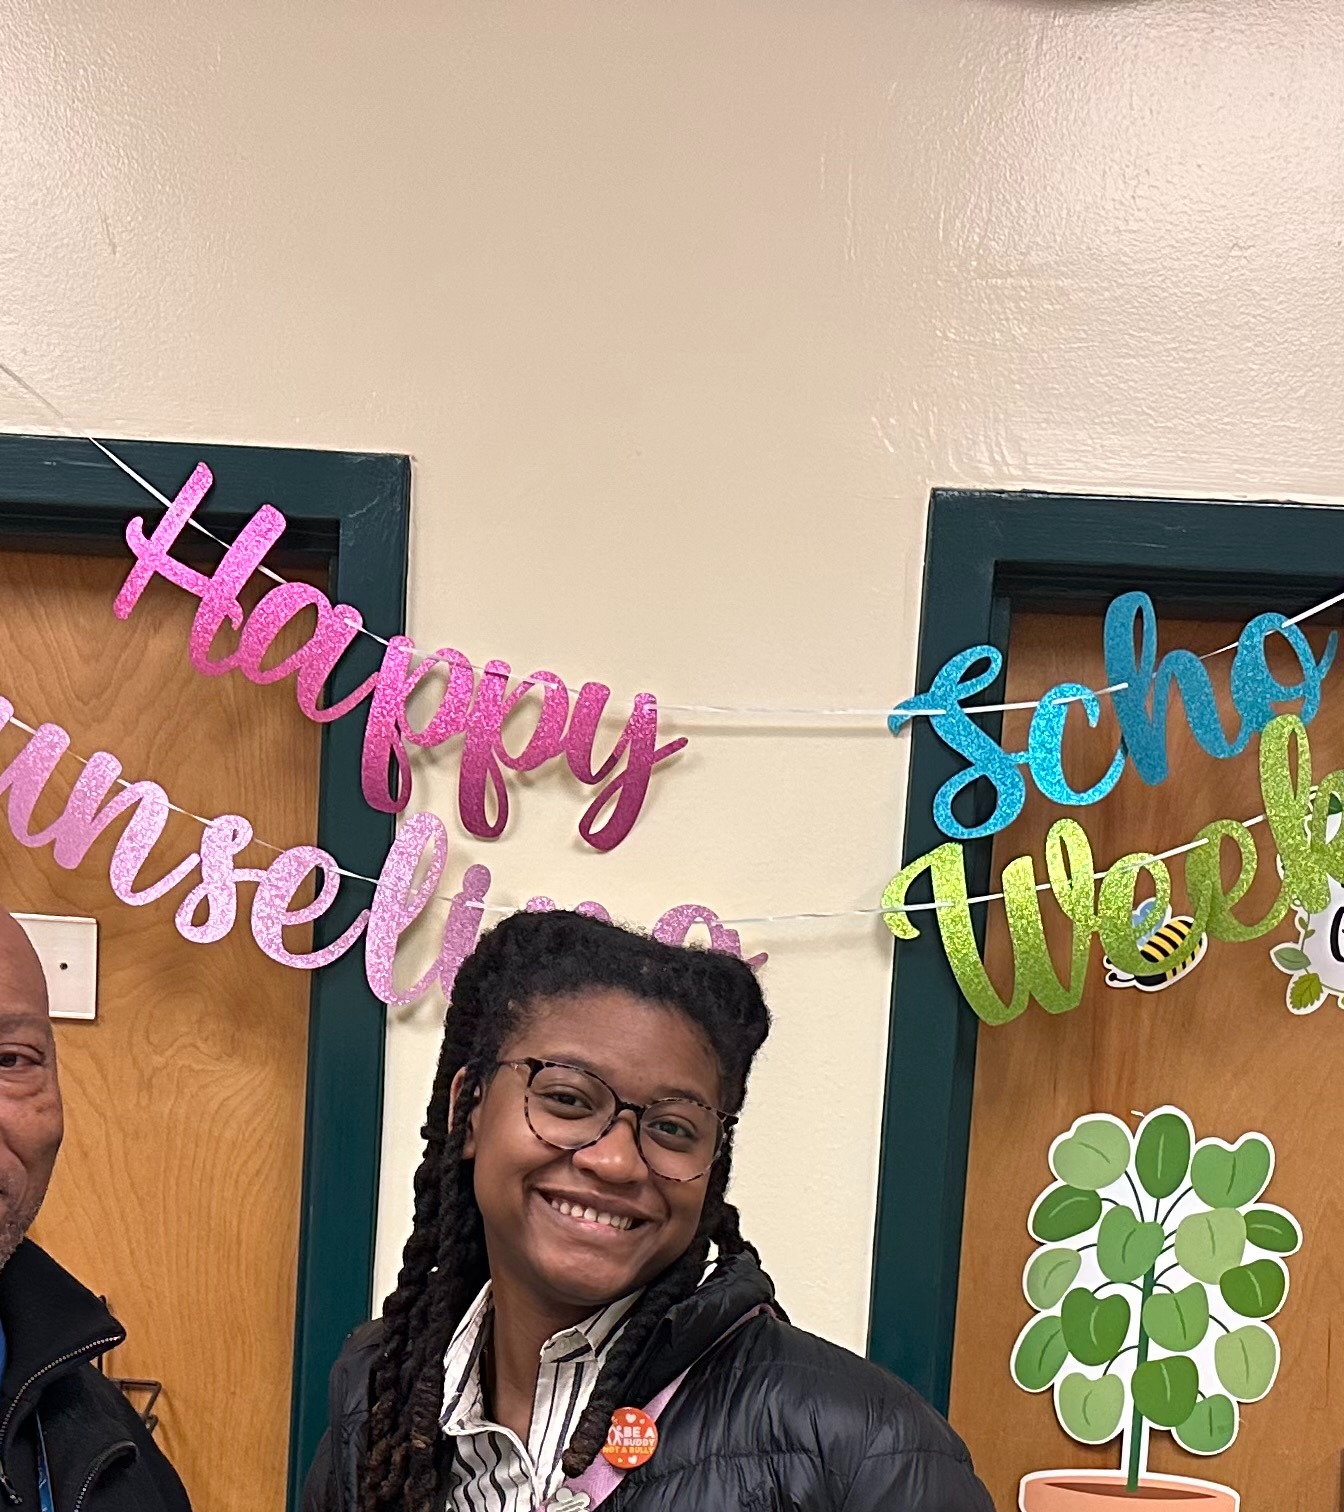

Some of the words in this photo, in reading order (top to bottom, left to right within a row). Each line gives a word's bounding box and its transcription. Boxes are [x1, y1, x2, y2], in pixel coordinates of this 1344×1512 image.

[112, 460, 689, 851] Happy
[623, 1426, 641, 1438] BE
[644, 1426, 656, 1438] A
[623, 1438, 655, 1447] BUDDY
[620, 1446, 628, 1454] A
[628, 1446, 655, 1455] BULLY
